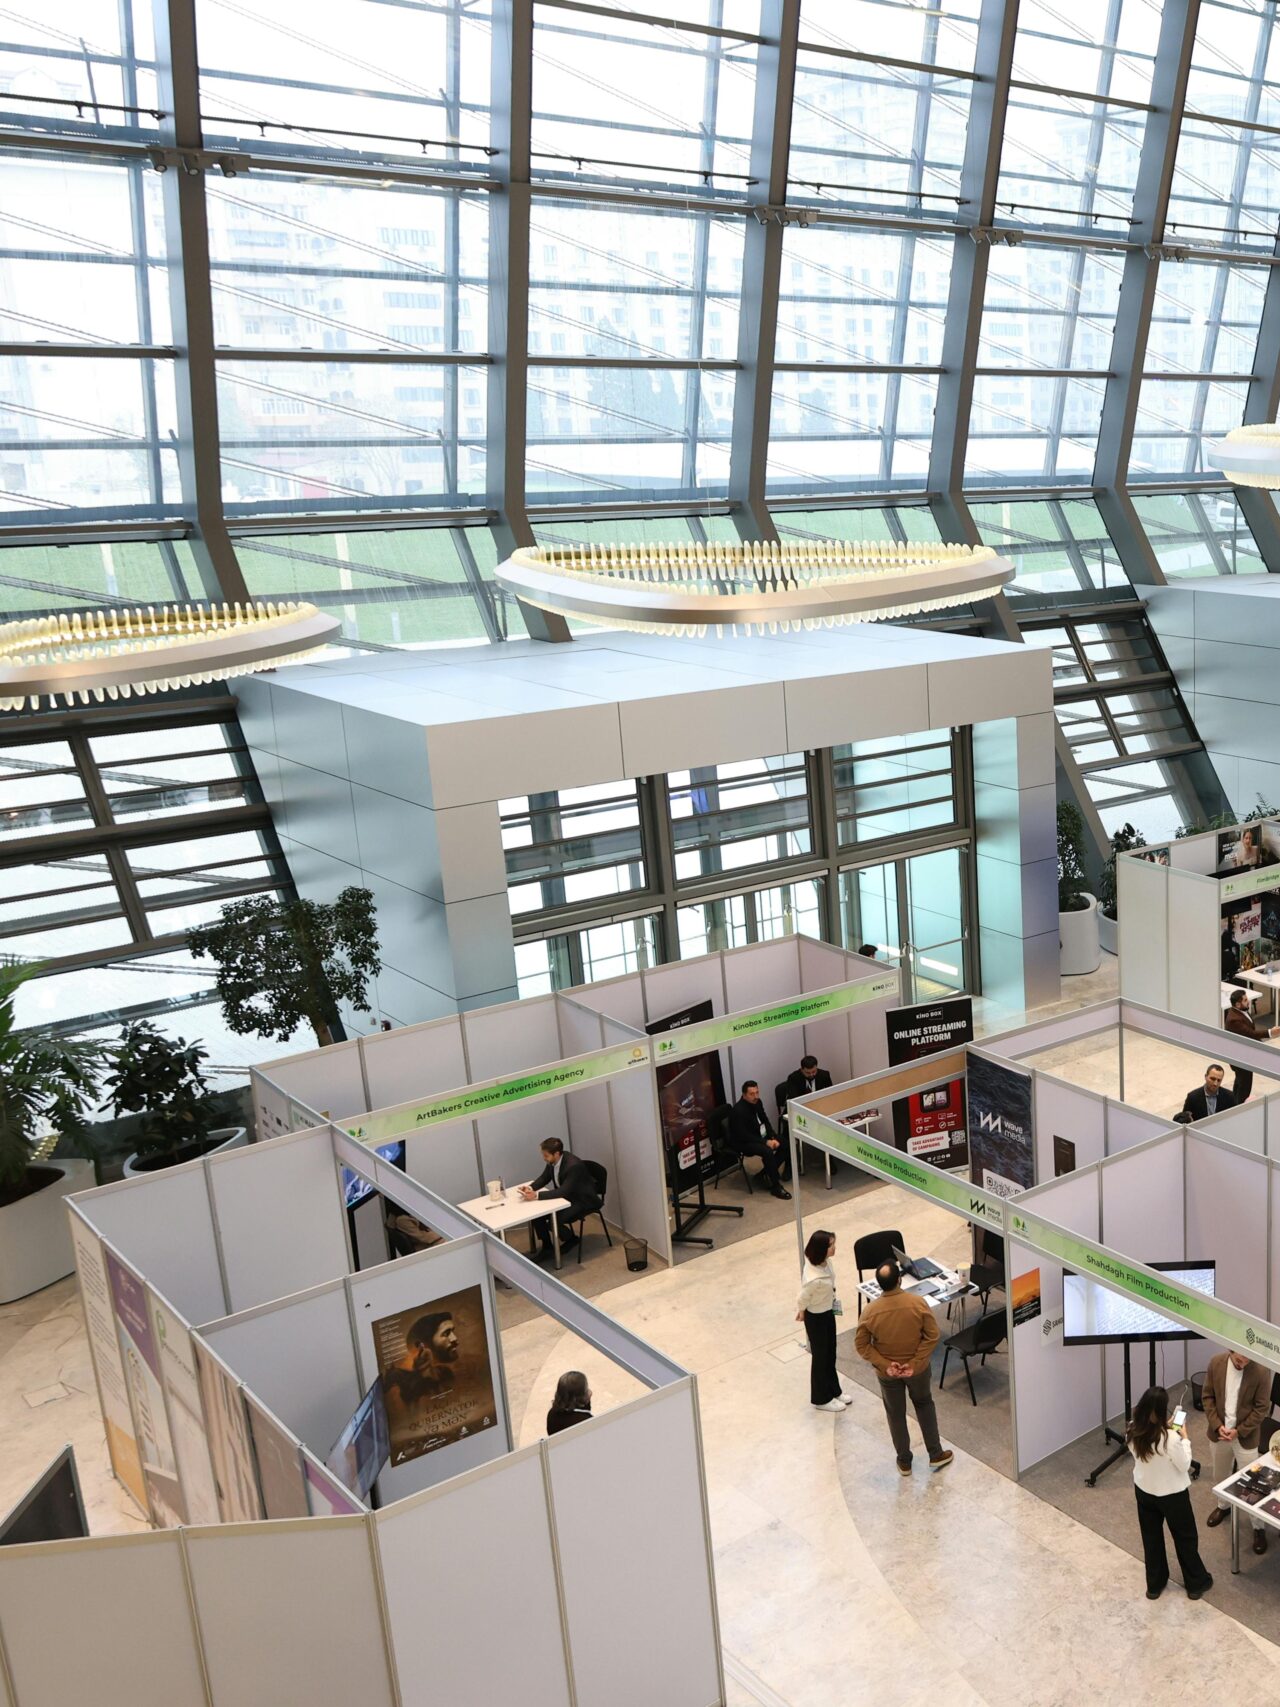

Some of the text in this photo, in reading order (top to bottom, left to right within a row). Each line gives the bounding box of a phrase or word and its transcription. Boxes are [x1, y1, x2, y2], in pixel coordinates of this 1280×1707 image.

[732, 999, 830, 1032] Kinobox Streaming Platform
[930, 1010, 942, 1018] BOX
[893, 1020, 967, 1040] ONLINE STREAMING
[911, 1032, 951, 1046] PLATFORM
[415, 1068, 585, 1122] ArtBakers Creative Advertising Agency
[1004, 1121, 1023, 1134] wave
[1004, 1130, 1026, 1145] media
[856, 1145, 927, 1185] Wave Media Production
[987, 1206, 1001, 1217] wave
[1086, 1254, 1190, 1310] Shahdagh Film Production
